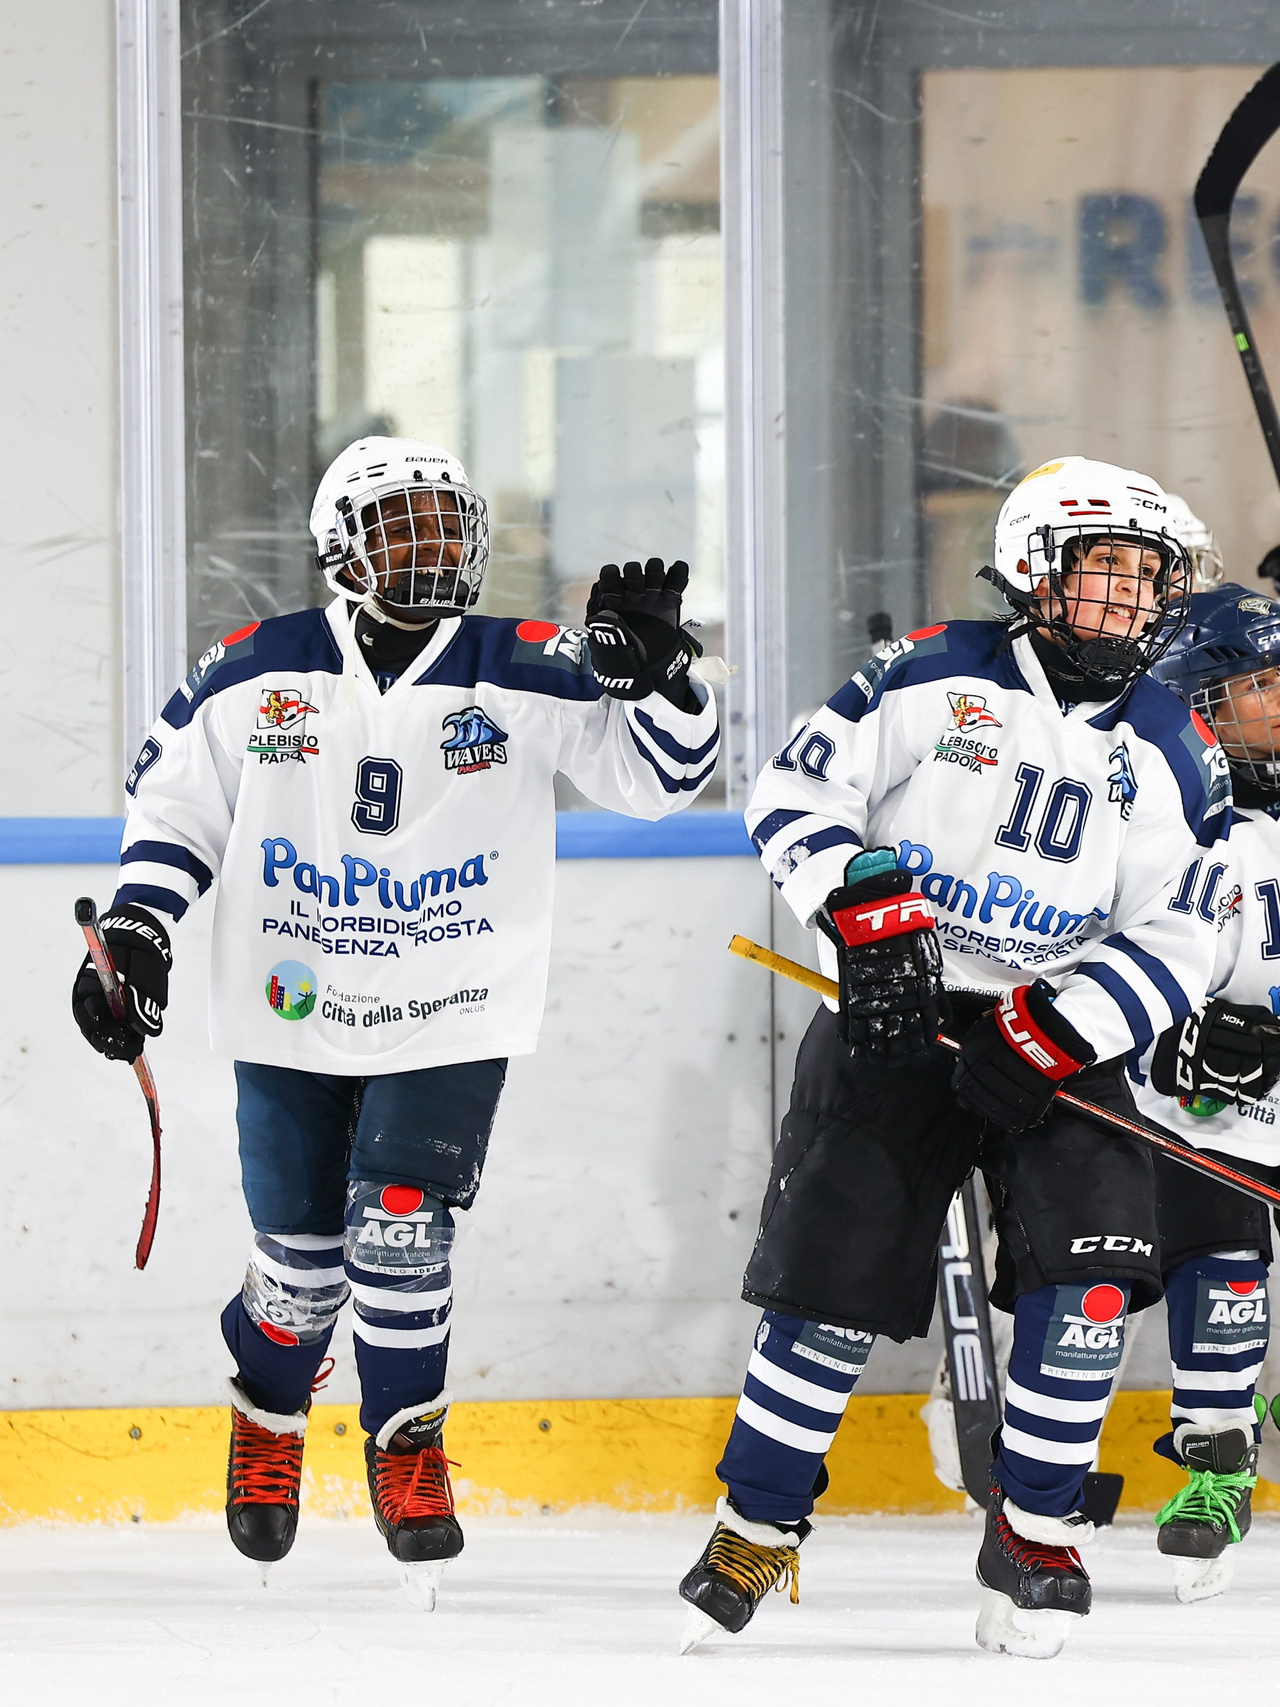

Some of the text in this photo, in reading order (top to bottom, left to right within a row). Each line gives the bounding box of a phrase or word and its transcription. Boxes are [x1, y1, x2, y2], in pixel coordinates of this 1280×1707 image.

[405, 456, 448, 465] BAUER
[1130, 497, 1168, 514] CCM
[1009, 513, 1031, 526] CCM
[446, 743, 508, 769] WAVES
[772, 722, 836, 782] 10
[939, 734, 998, 760] LEBISCITO
[351, 756, 403, 836] 9
[995, 762, 1093, 864] 10
[290, 900, 309, 918] IL
[322, 938, 401, 958] SENZA
[362, 1004, 404, 1028] della
[408, 987, 489, 1020] Speranza
[459, 1004, 486, 1015] ONLUS
[357, 1220, 433, 1248] AGL
[1070, 1235, 1154, 1258] CCM
[1207, 1301, 1267, 1325] AGL
[1057, 1324, 1122, 1350] AGL
[1206, 1325, 1264, 1335] manifatture grafiche
[1055, 1349, 1097, 1361] manifatture
